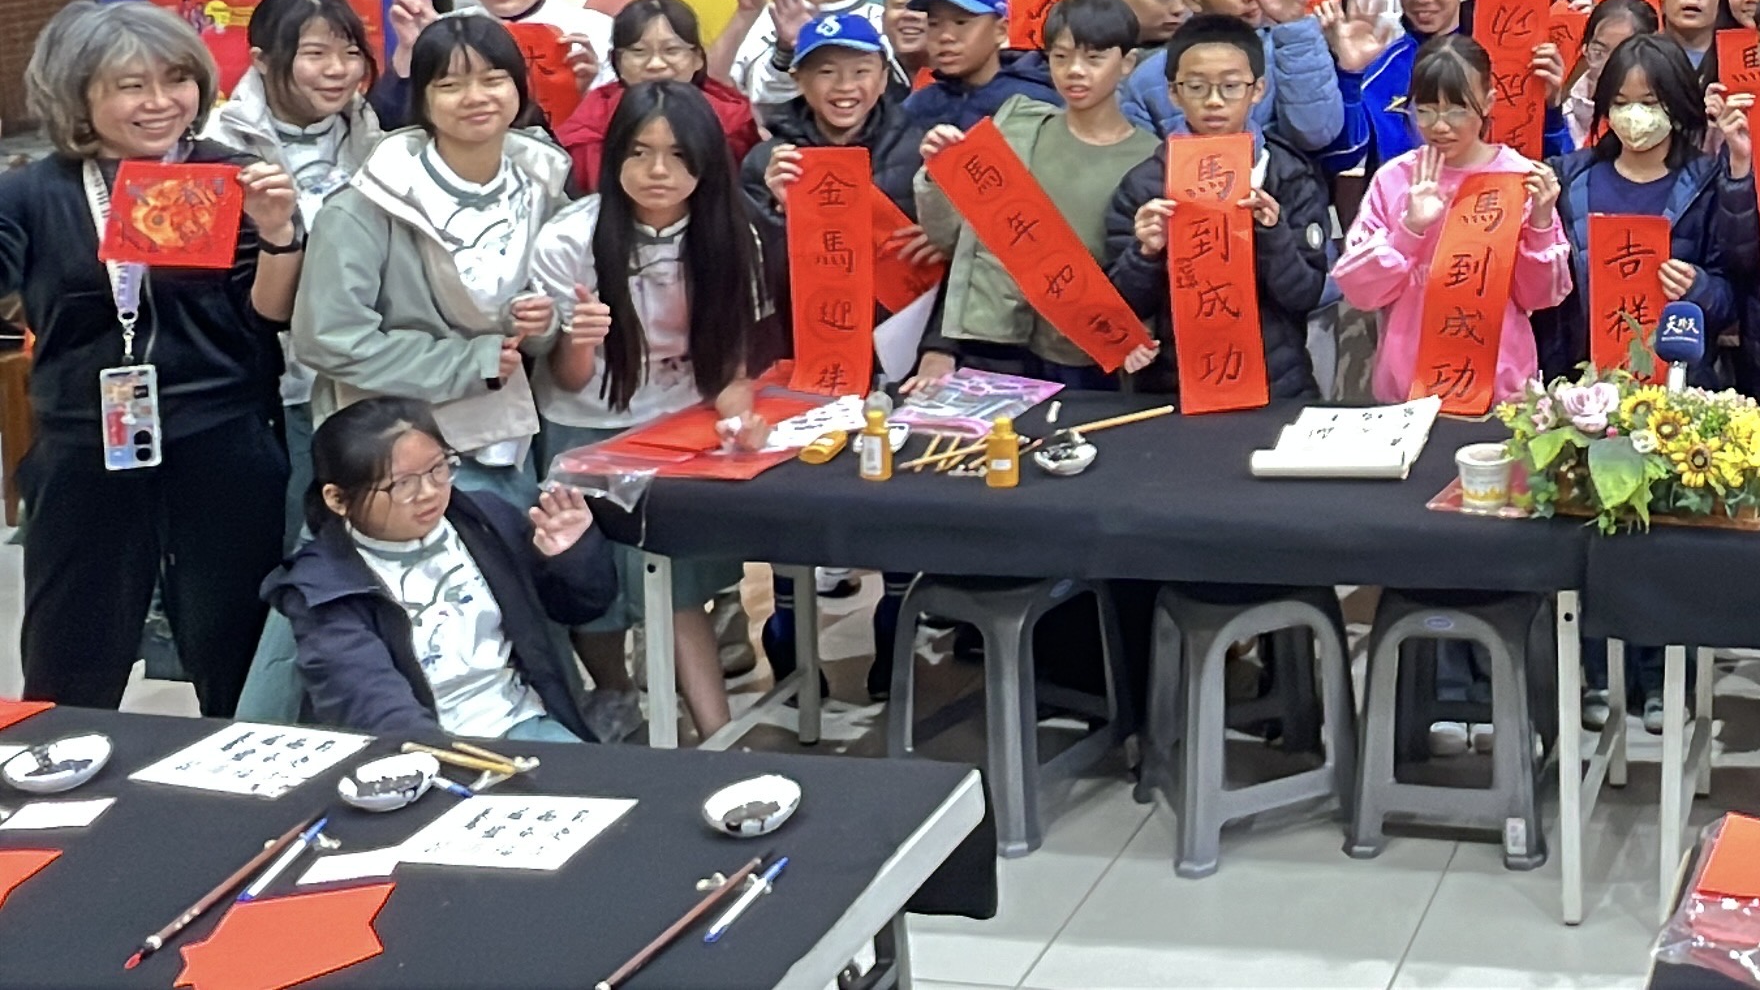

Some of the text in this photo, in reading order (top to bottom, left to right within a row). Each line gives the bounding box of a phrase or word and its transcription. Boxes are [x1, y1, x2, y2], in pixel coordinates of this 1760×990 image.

[806, 170, 859, 393] 金馬迎祥
[961, 150, 1130, 346] 馬年如意
[1184, 152, 1244, 385] 馬到成功
[1423, 187, 1511, 401] 馬到成功
[1604, 228, 1657, 382] 吉祥
